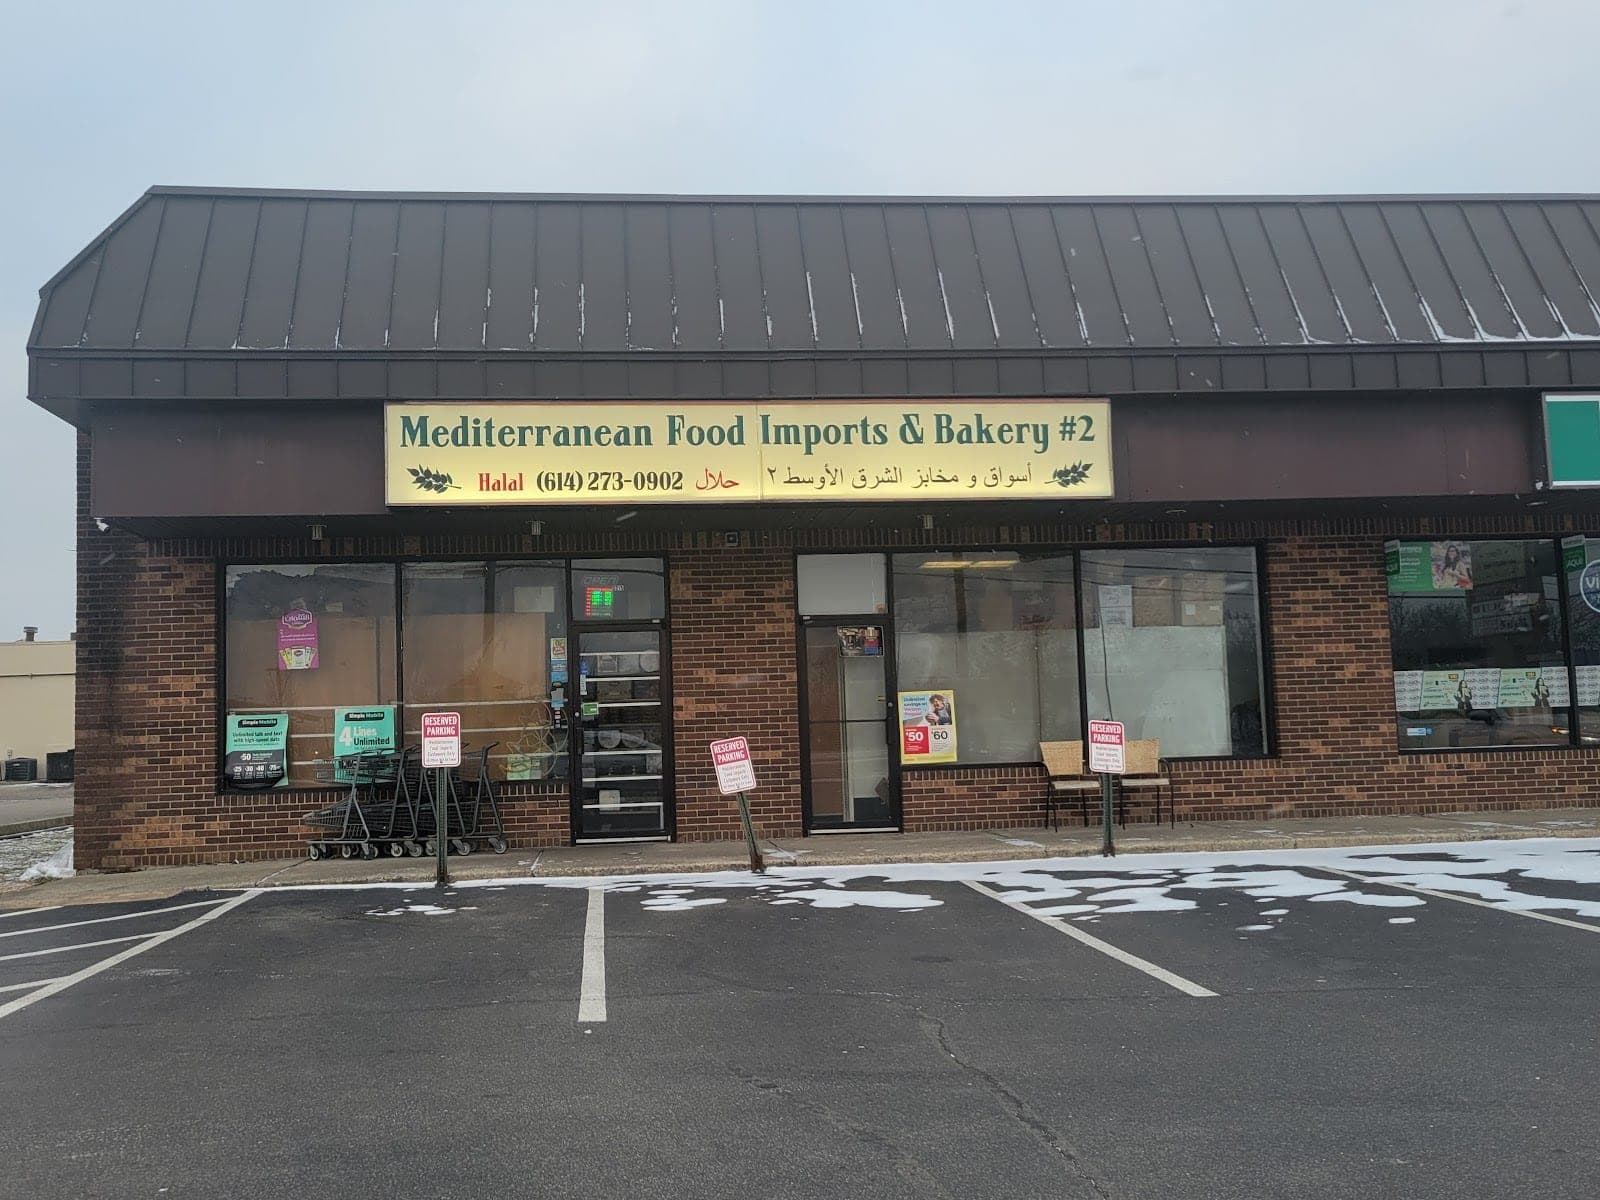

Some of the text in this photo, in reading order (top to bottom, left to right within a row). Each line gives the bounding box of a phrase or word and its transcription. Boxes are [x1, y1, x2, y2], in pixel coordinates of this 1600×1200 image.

[400, 413, 1096, 455] Mediterranean Food Imports & Bakery #2
[478, 472, 524, 492] Halal
[695, 467, 740, 491] حلال
[851, 465, 903, 489] الشرق
[912, 467, 959, 489] مخابز
[983, 462, 1032, 488] أسواق
[424, 715, 458, 726] RESERVED
[353, 726, 377, 737] Lines
[426, 726, 456, 737] PARKING
[1091, 723, 1122, 734] RESERVED
[340, 727, 351, 747] 4
[353, 736, 390, 746] Unlimited
[1093, 733, 1120, 744] PARKING
[713, 740, 744, 754] RESERVED
[717, 750, 745, 764] PARKING
